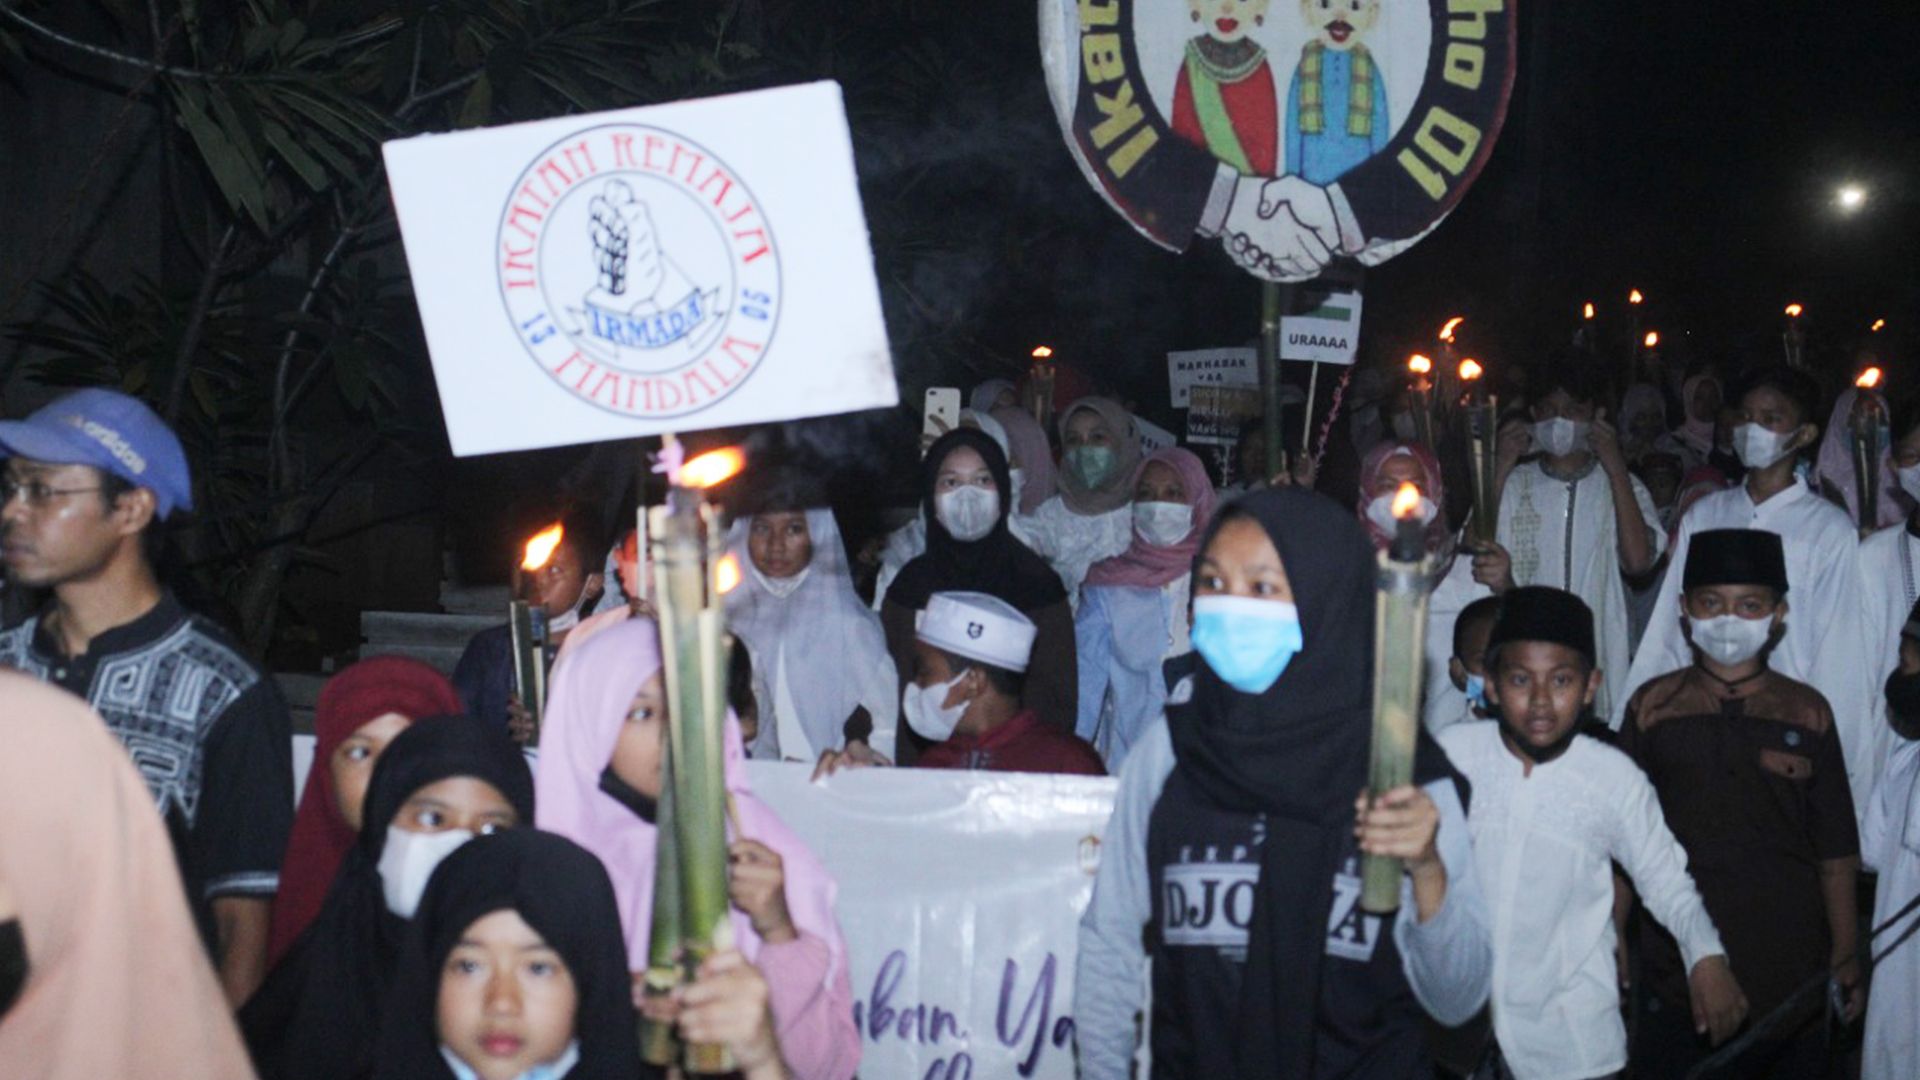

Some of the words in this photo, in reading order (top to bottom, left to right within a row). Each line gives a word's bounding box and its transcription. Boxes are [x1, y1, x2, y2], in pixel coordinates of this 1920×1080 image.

[505, 142, 597, 288] IKATAN
[612, 133, 769, 263] REMAJA
[586, 294, 704, 347] IRMADA
[1289, 333, 1348, 349] URAAAA
[553, 335, 761, 411] MANDALA
